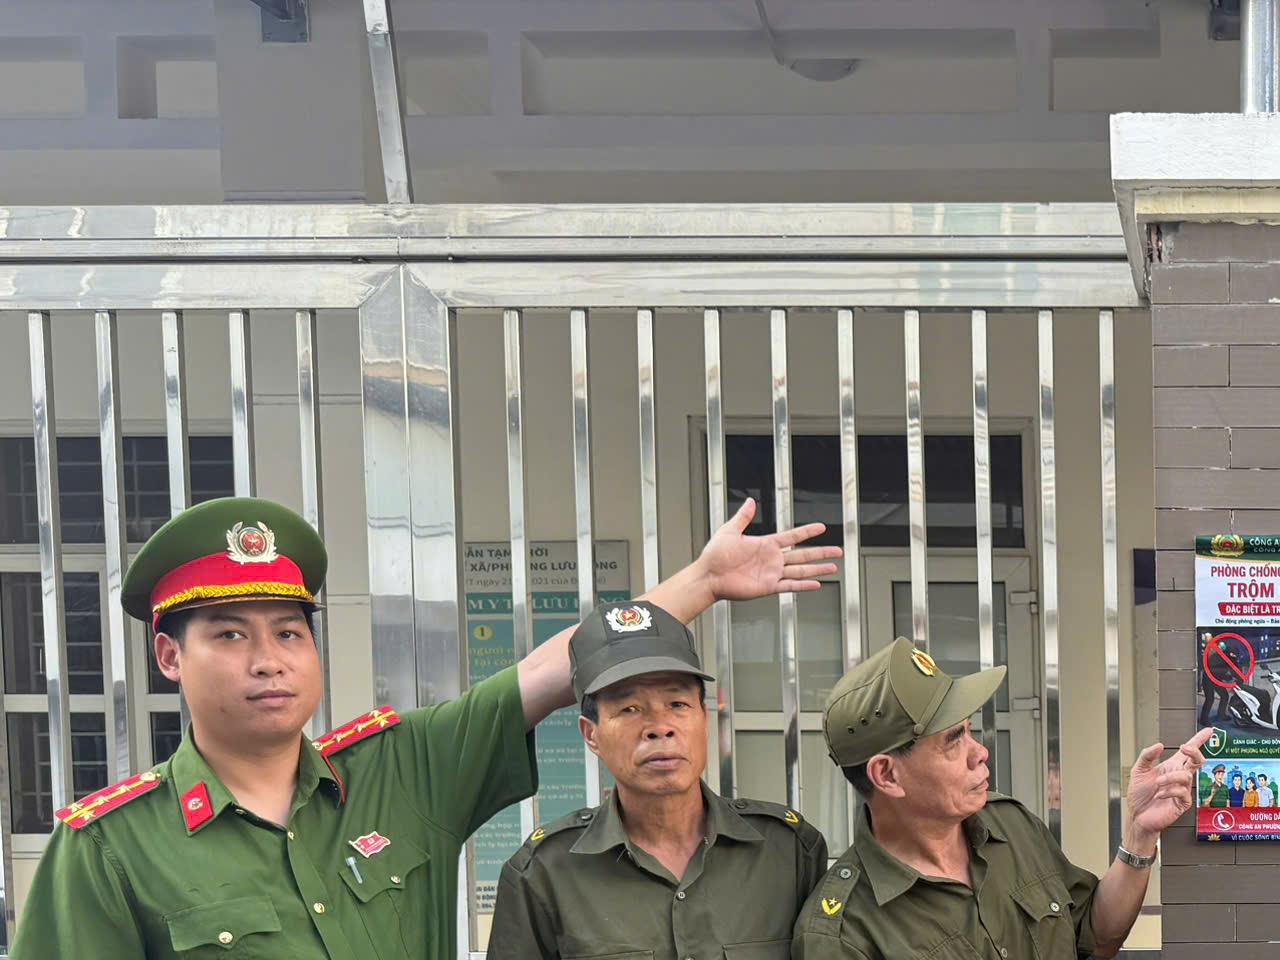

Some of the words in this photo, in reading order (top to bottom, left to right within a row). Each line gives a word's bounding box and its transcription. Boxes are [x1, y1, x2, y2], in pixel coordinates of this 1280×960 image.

[1250, 537, 1272, 546] CÔNG
[1211, 564, 1246, 577] PHÒNG
[1227, 579, 1275, 602] TRỘM
[1243, 604, 1260, 616] BIỆT
[1261, 604, 1271, 614] LÀ
